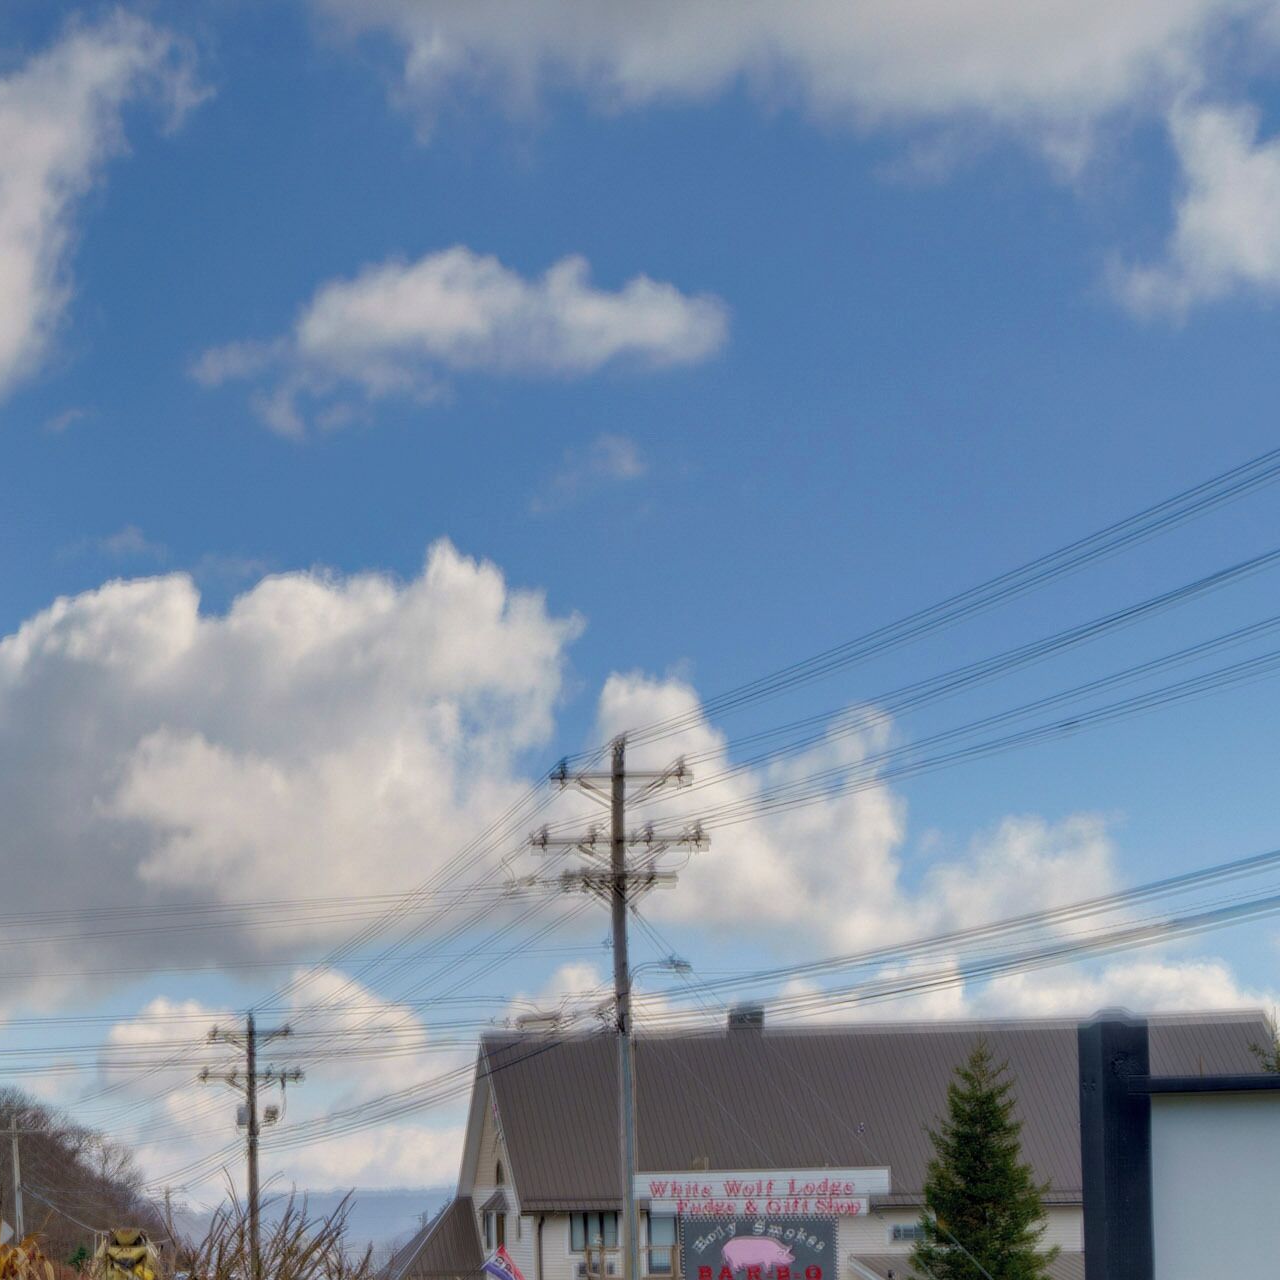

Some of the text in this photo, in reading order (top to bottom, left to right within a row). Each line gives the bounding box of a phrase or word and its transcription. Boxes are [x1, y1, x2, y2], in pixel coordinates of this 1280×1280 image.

[649, 1177, 855, 1198] White Wolf Lodge
[676, 1196, 861, 1217] Fudge & Gift Shop
[692, 1219, 826, 1255] Holy Smokes
